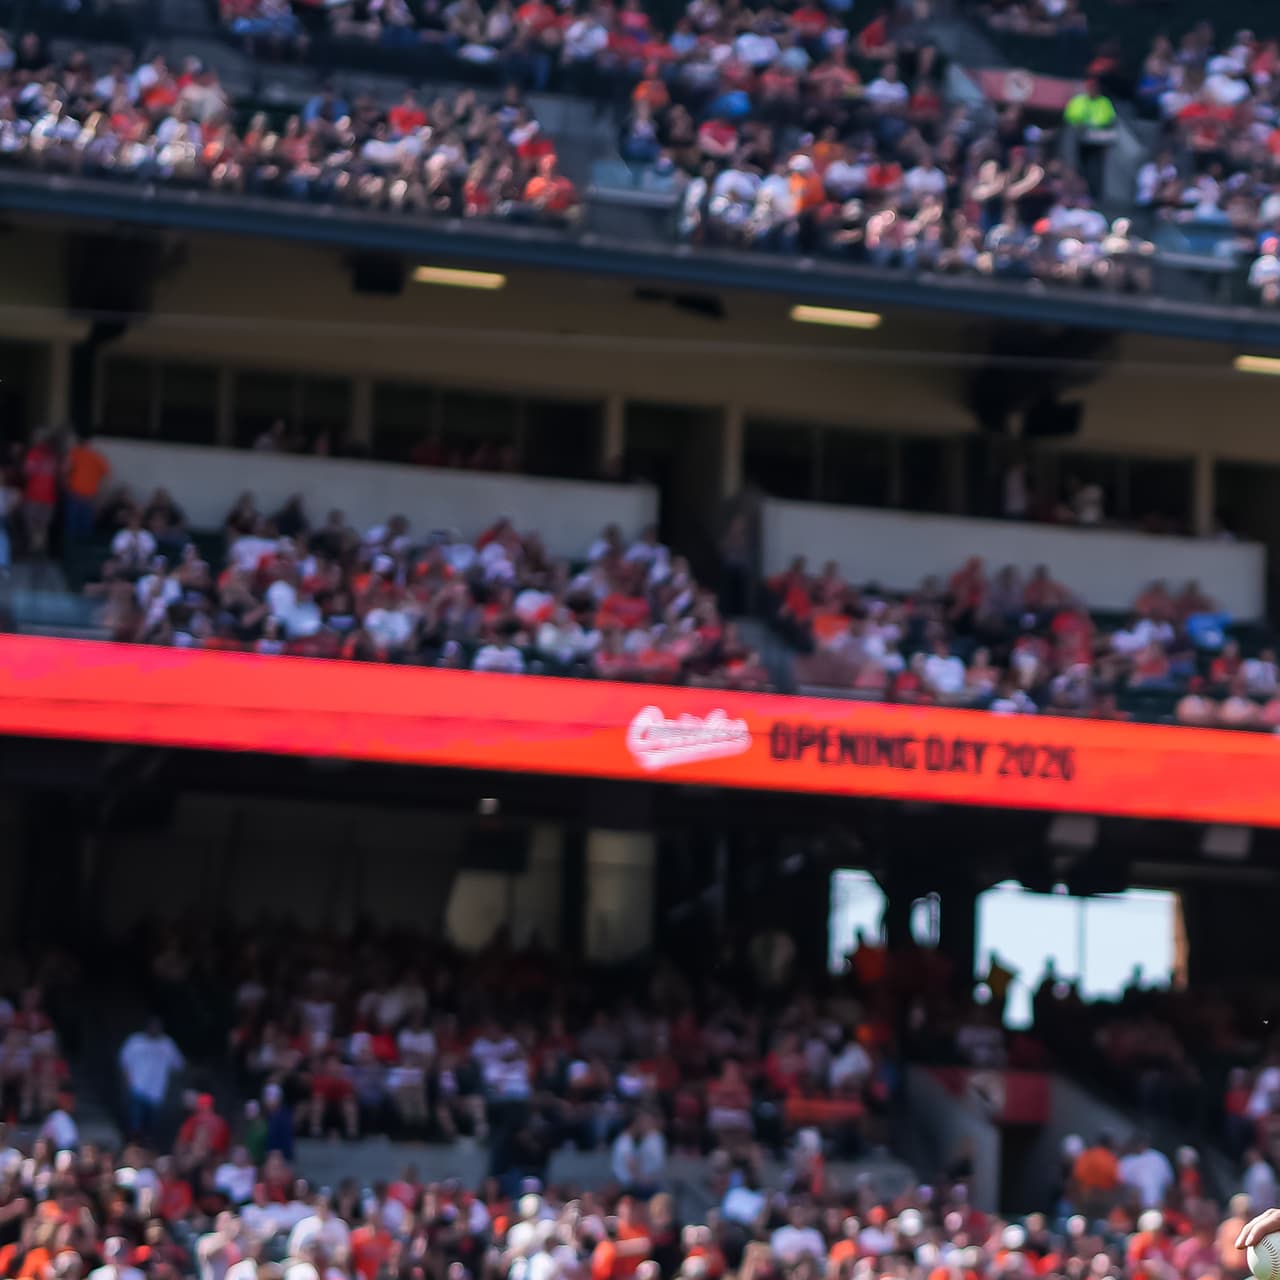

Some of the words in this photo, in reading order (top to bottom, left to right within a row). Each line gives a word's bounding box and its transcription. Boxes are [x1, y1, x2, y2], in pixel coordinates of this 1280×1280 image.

[770, 721, 915, 769] OPENING
[924, 737, 989, 774] DAY
[997, 742, 1076, 781] 2026
